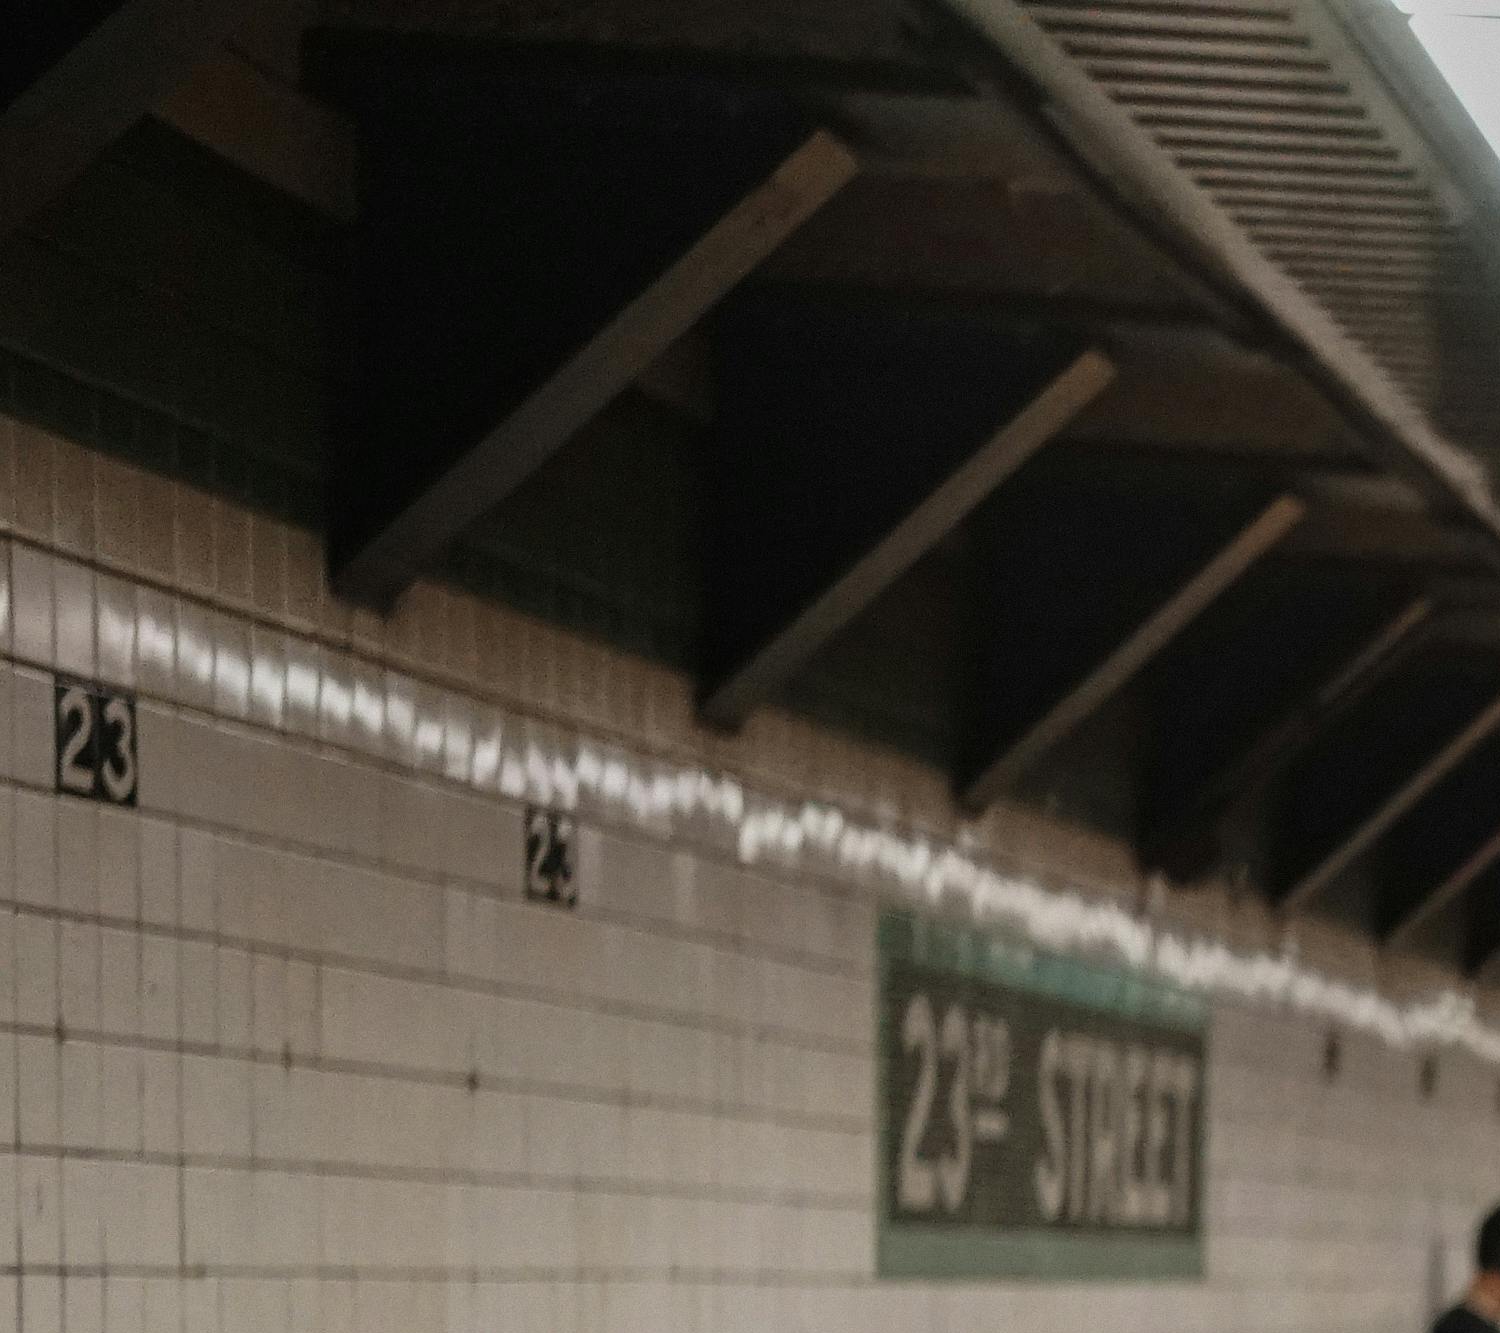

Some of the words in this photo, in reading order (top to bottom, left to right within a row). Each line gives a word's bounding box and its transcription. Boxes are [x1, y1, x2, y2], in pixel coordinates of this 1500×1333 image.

[59, 684, 134, 801] 23
[529, 814, 577, 904] 23
[1034, 1028, 1197, 1227] STREET
